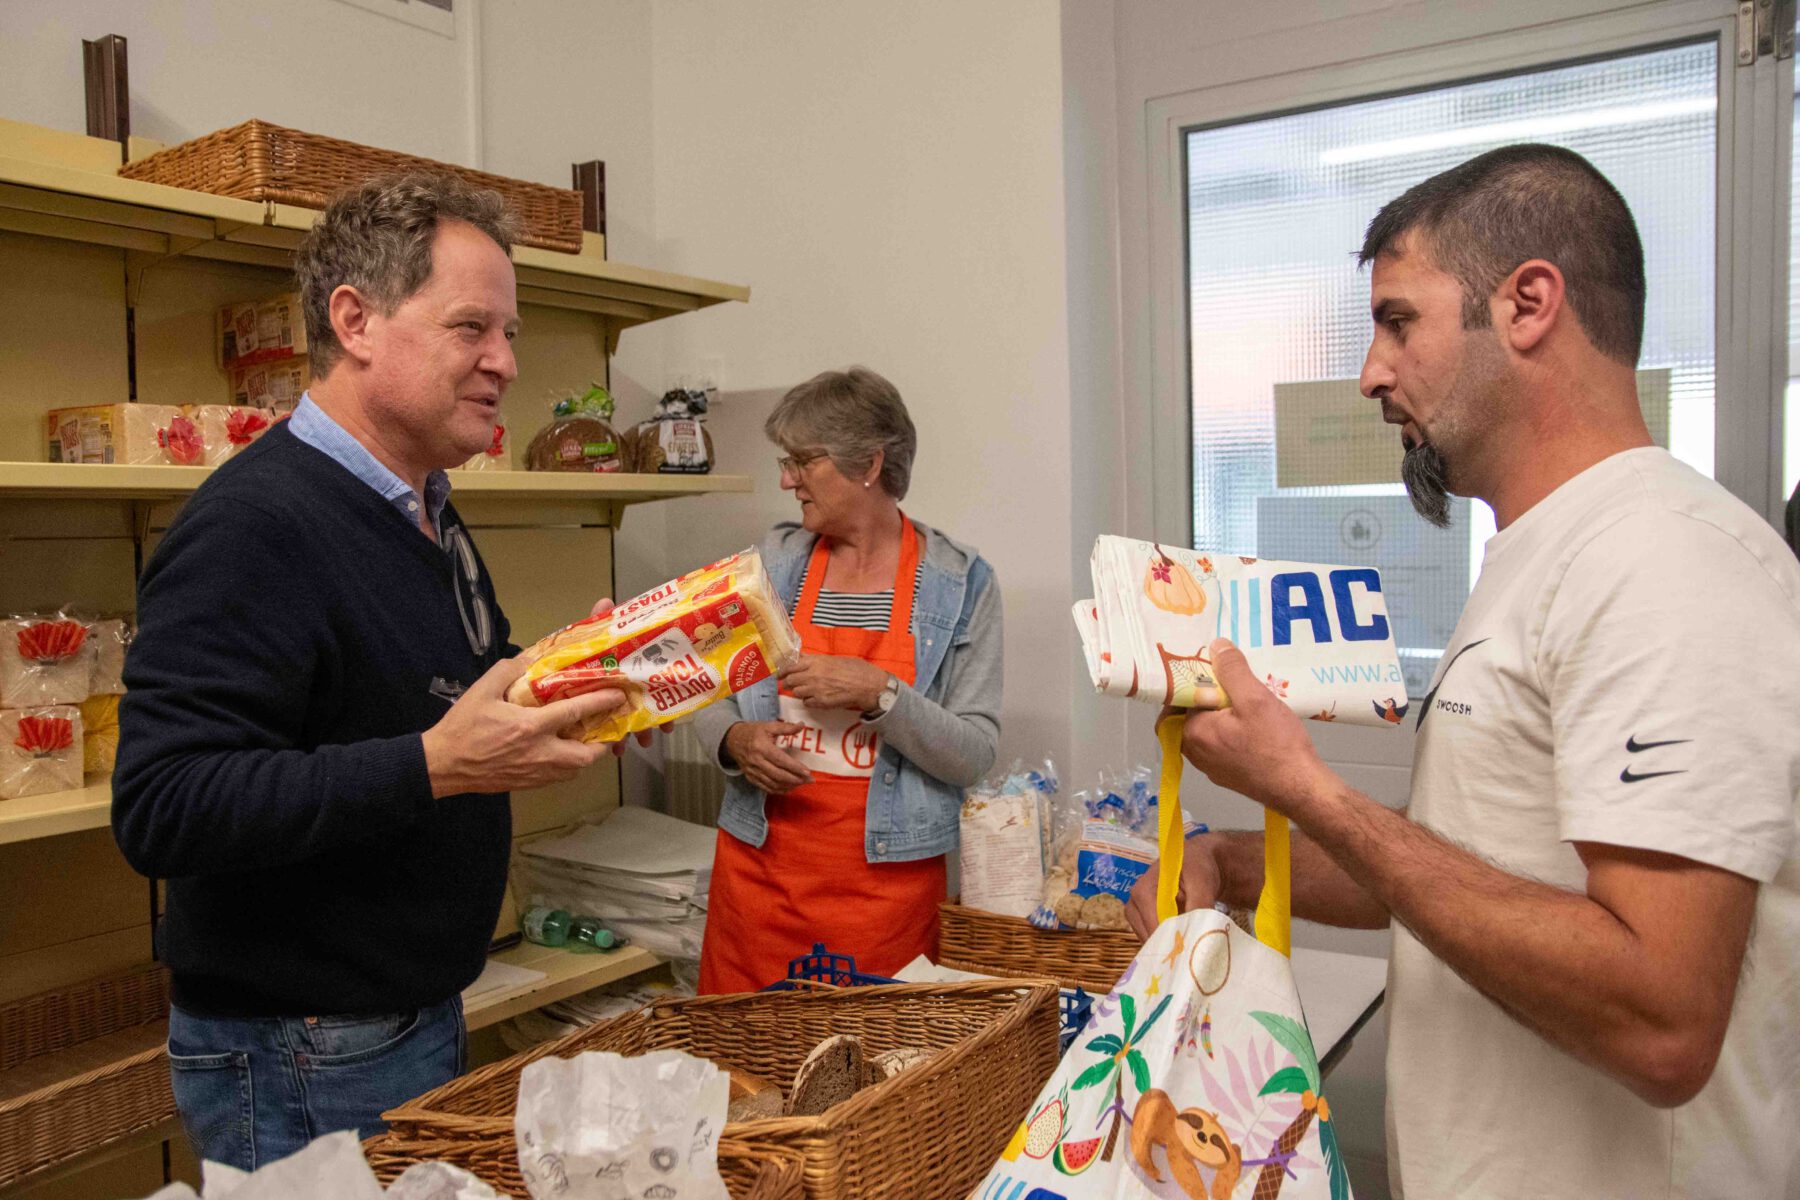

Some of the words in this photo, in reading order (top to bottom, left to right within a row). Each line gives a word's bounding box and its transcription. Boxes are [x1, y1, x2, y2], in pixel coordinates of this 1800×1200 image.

[1270, 568, 1390, 646] AC
[641, 653, 704, 693] TOAST
[650, 671, 717, 711] BUTTER
[1436, 699, 1473, 716] SWOOSH
